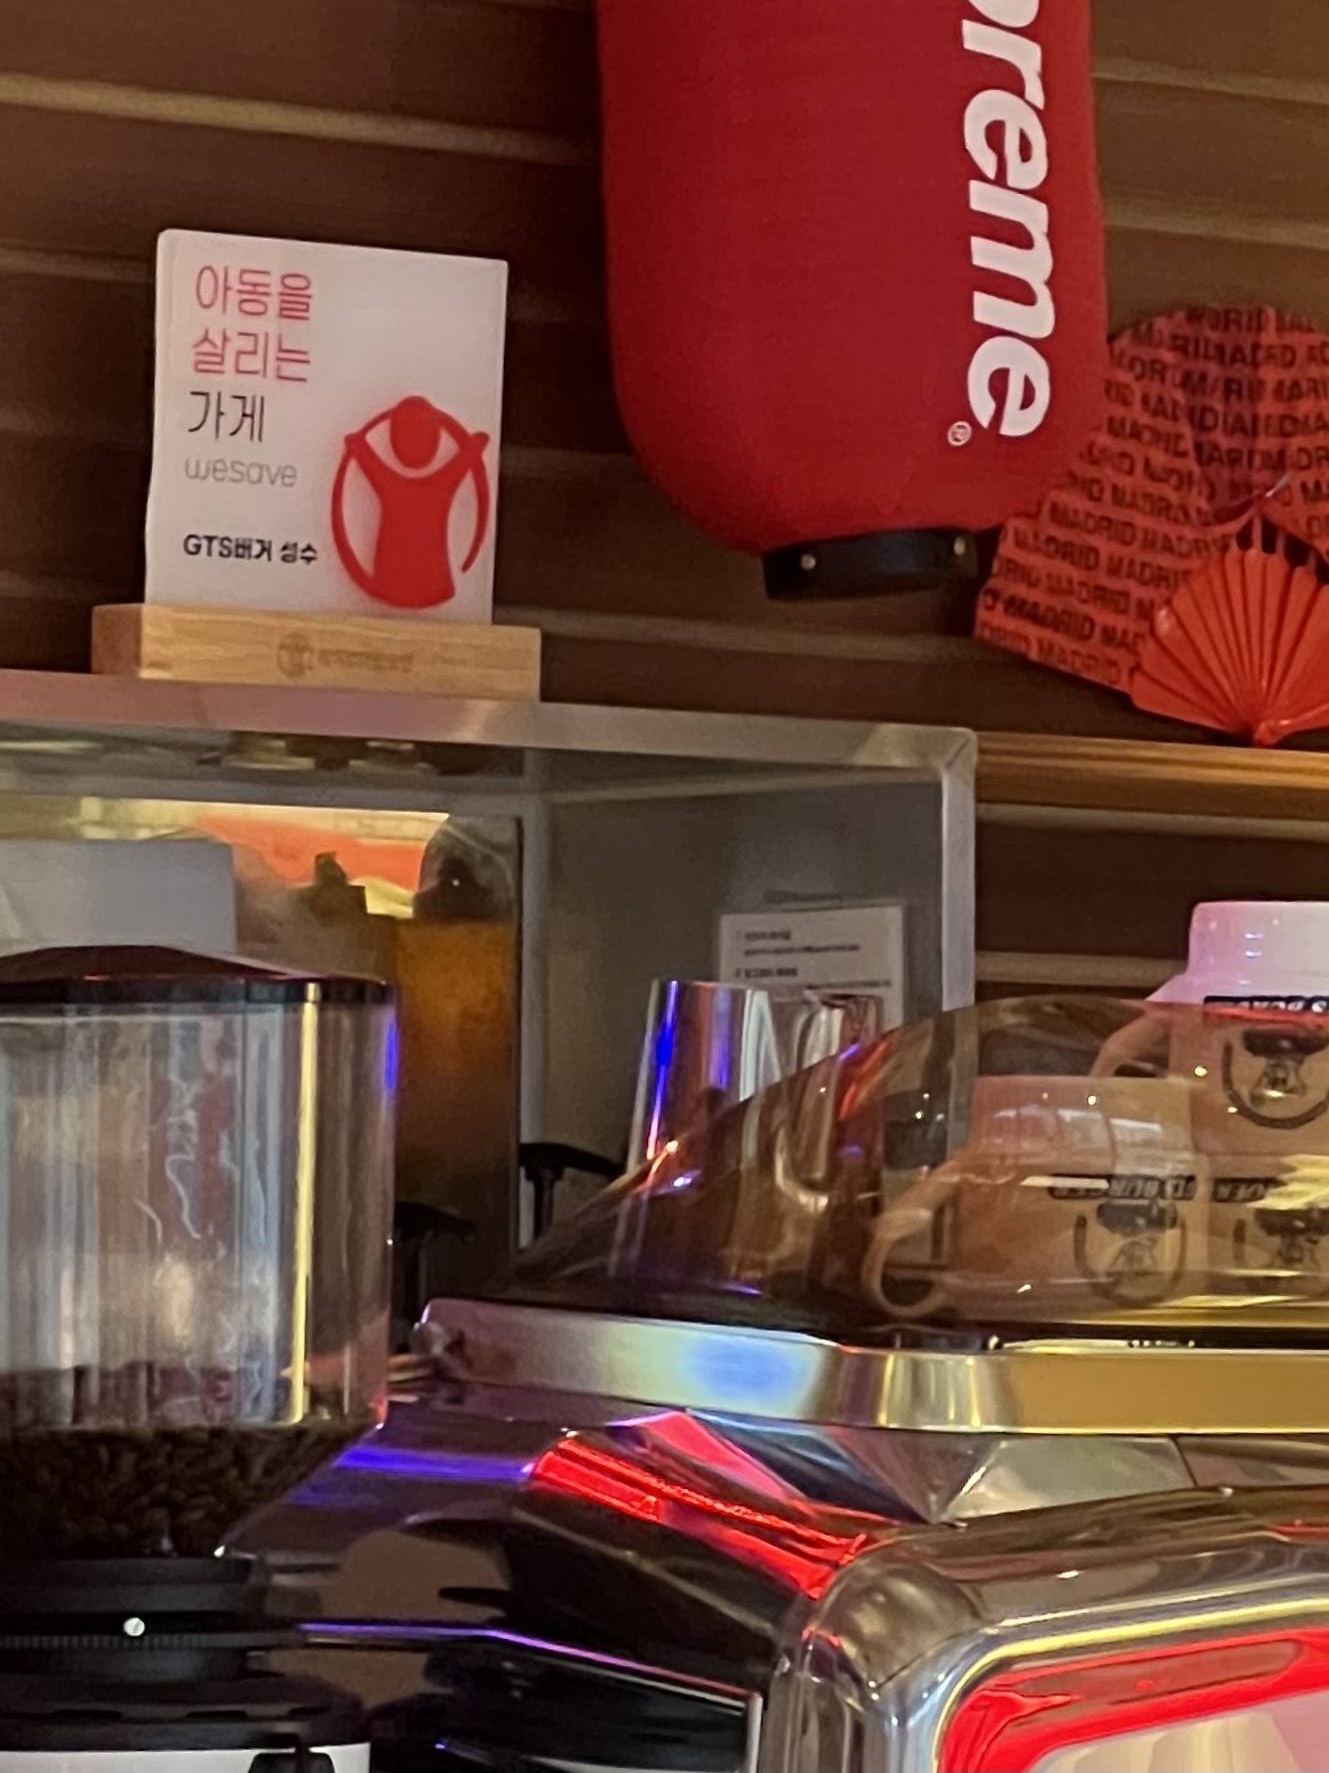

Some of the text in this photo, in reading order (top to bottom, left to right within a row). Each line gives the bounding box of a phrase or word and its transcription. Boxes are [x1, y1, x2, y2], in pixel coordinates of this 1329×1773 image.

[195, 264, 314, 321] 아동을
[191, 327, 312, 383] 살리는
[187, 389, 266, 444] 가게
[184, 455, 298, 488] wesave
[183, 533, 318, 566] GTS버거 성수
